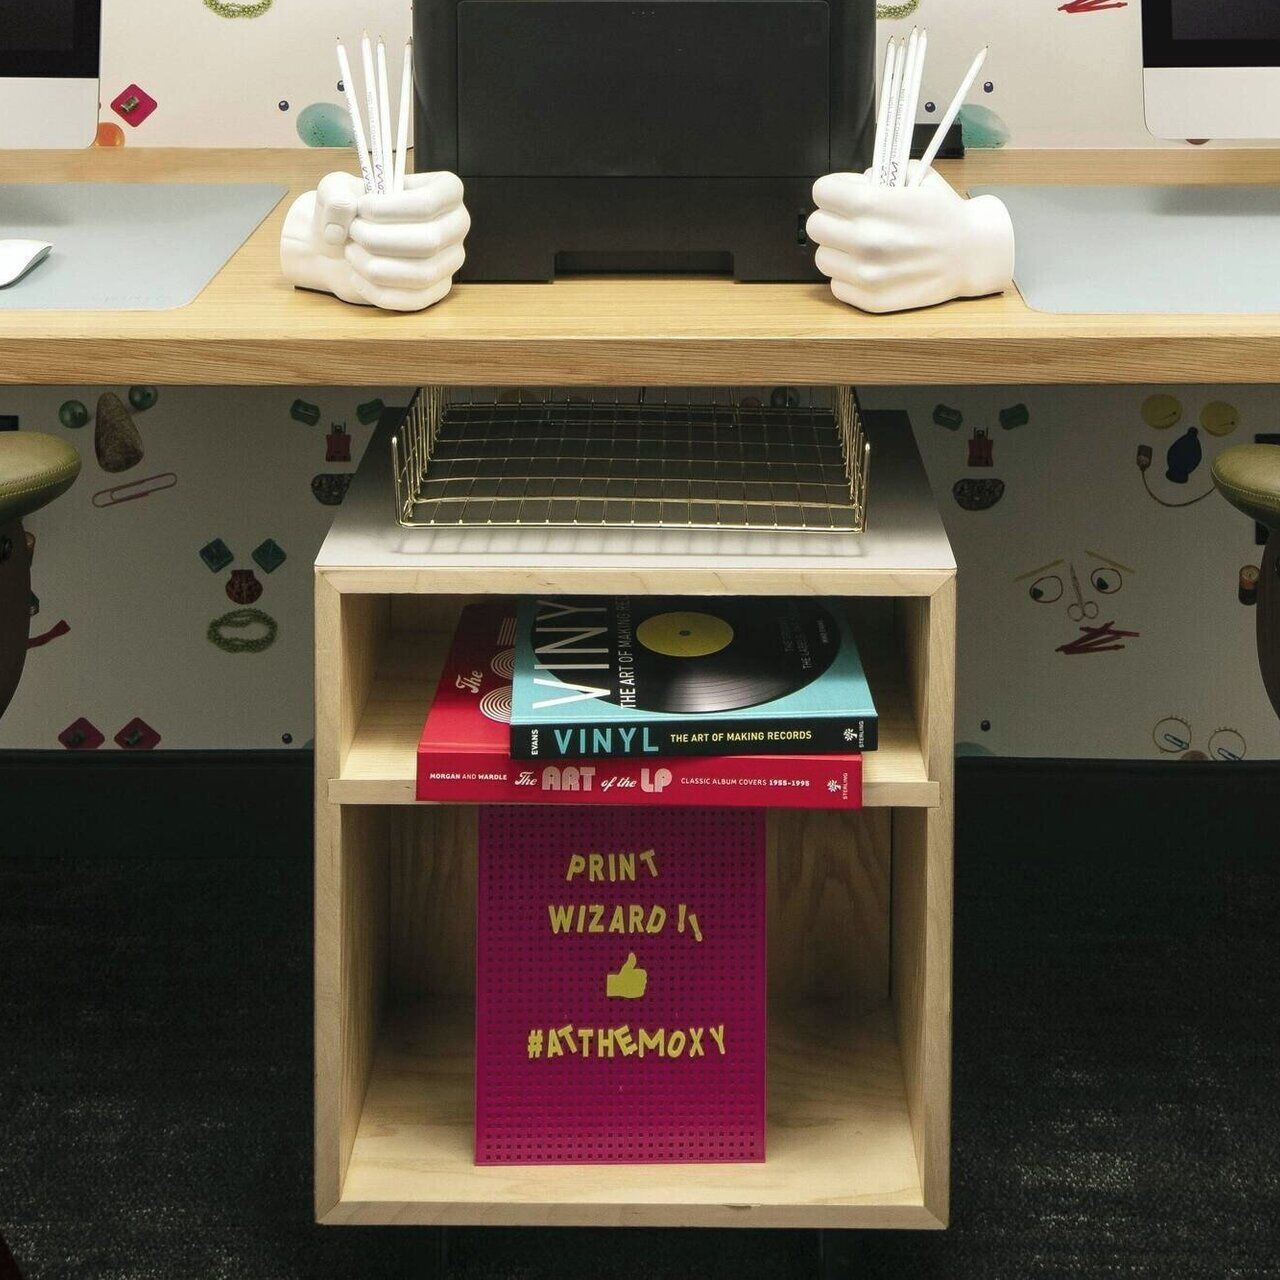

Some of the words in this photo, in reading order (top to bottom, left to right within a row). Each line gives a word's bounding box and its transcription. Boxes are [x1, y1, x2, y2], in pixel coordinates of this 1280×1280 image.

[617, 613, 632, 648] MAKING
[532, 600, 611, 710] VINY
[618, 650, 633, 663] OF
[456, 670, 484, 694] The
[619, 666, 635, 686] ART
[620, 688, 636, 709] THE
[554, 728, 659, 754] VINYL
[670, 734, 688, 743] THE
[691, 734, 709, 742] ART
[712, 733, 724, 742] OF
[726, 732, 764, 741] MAKING
[768, 731, 812, 740] RECORDS
[515, 772, 537, 786] The
[542, 766, 596, 792] ART
[601, 776, 617, 792] of
[617, 776, 637, 788] the
[640, 768, 672, 792] LP
[566, 849, 658, 882] PRINT
[528, 1024, 725, 1059] #ATTHEMOXY
